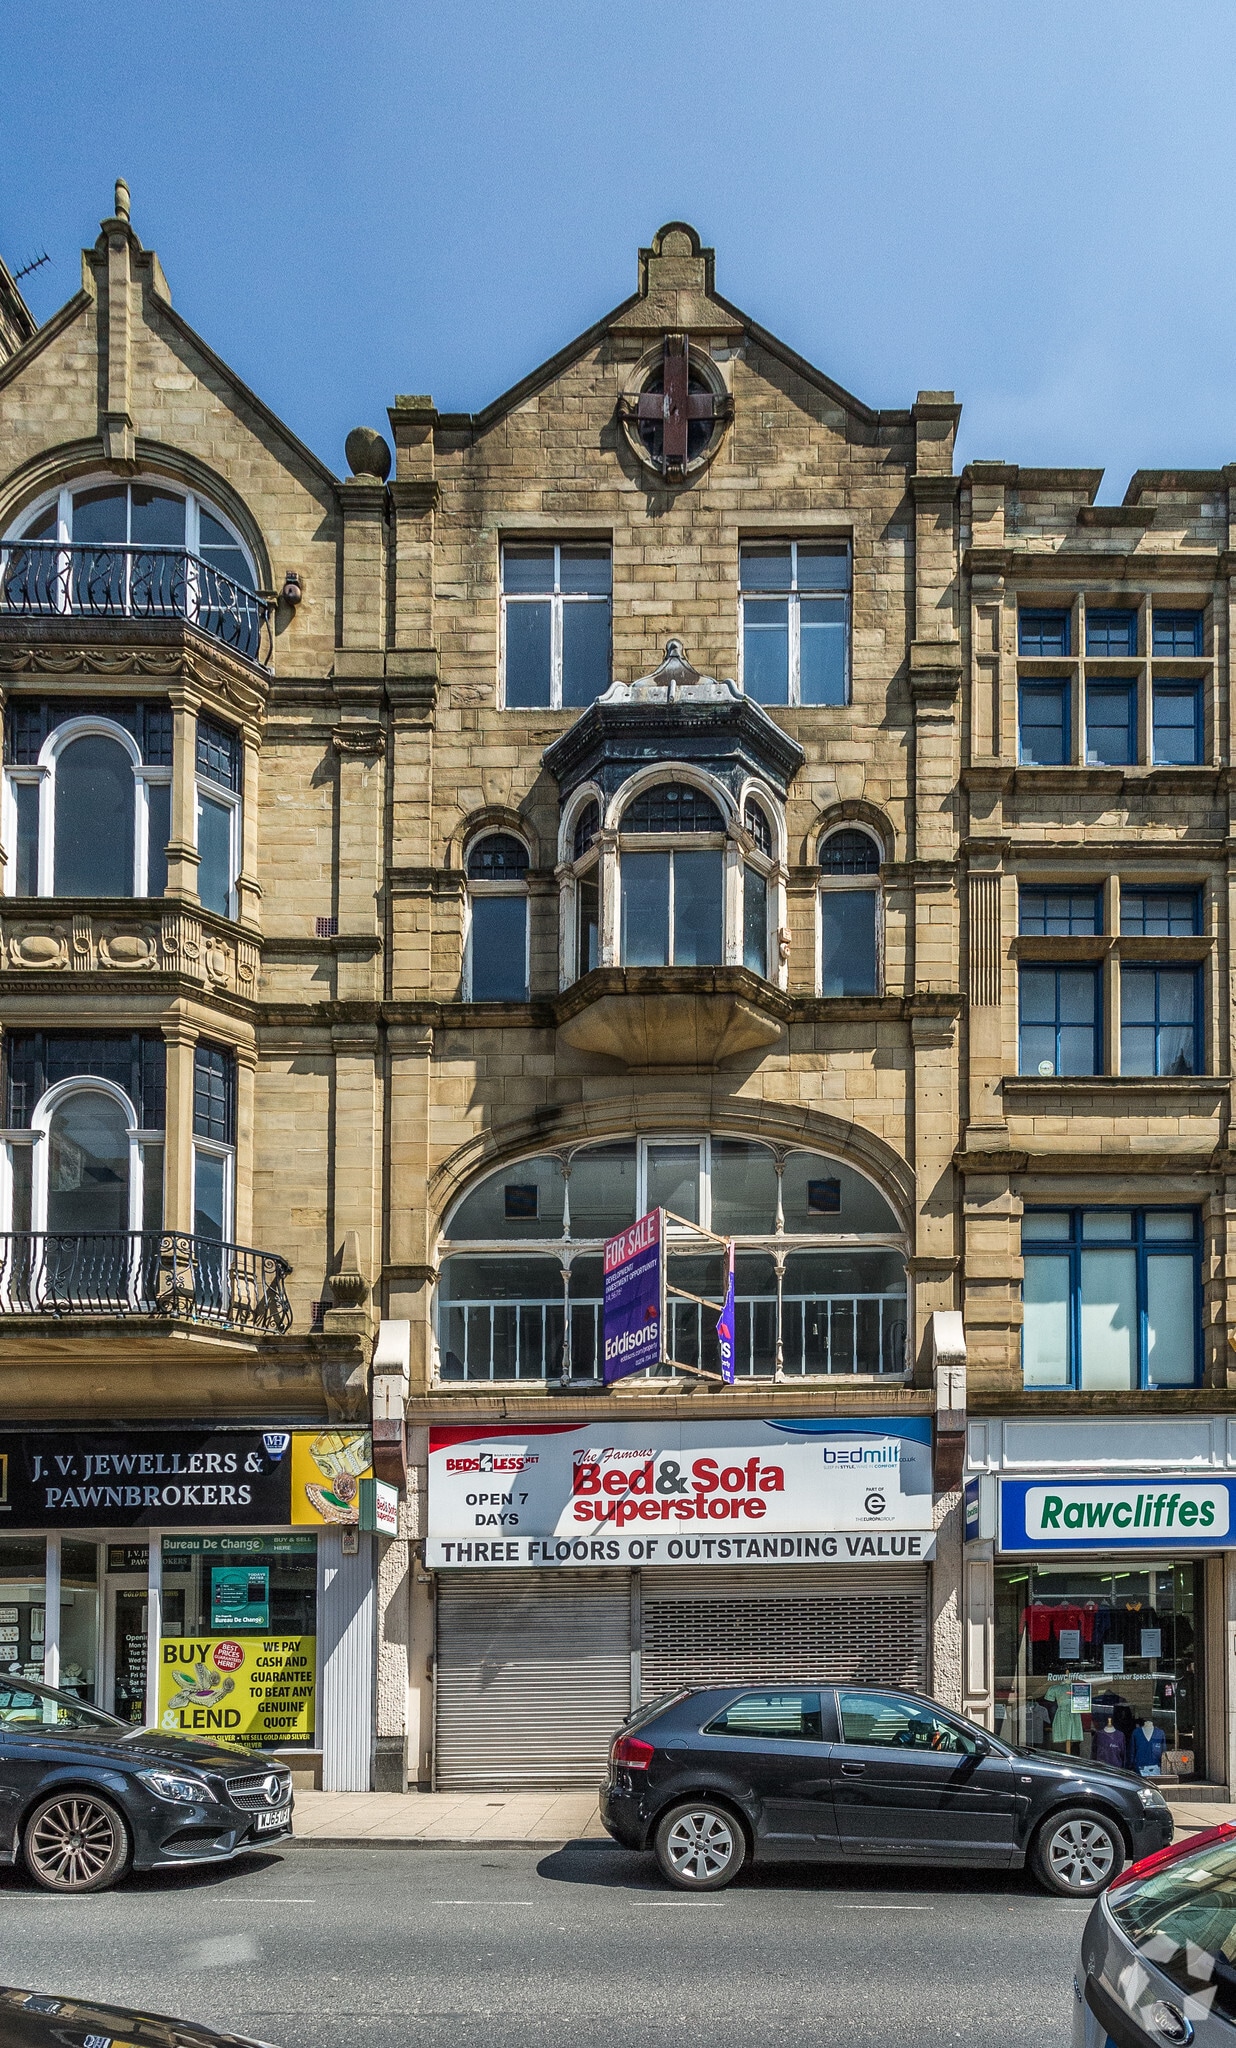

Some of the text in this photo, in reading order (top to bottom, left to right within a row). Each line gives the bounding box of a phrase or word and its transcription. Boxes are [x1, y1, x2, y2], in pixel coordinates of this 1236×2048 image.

[606, 1215, 655, 1271] FOR SALE
[605, 1258, 658, 1294] INVESTMENT OPPORTUNITY
[605, 1322, 658, 1361] Eddisons
[572, 1447, 654, 1466] The Famous
[32, 1452, 264, 1483] J. V. JEWELLERS &
[45, 1484, 252, 1508] PAWNBROKERS
[465, 1493, 529, 1506] OPEN 7
[573, 1493, 767, 1527] superstore
[1041, 1493, 1215, 1529] Rawcliffes
[475, 1513, 519, 1526] DAYS
[163, 1539, 260, 1550] Bureau De Change
[441, 1536, 921, 1562] THREE FLOORS OF OUTSTANDING VALUE
[243, 1616, 262, 1624] Change
[222, 1643, 239, 1652] BEST
[263, 1641, 302, 1652] WE PAY
[163, 1644, 211, 1664] BUY
[214, 1654, 242, 1663] GUARANTEED
[218, 1648, 240, 1659] PRICES
[217, 1659, 237, 1668] HERE!
[256, 1656, 307, 1667] CASH AND
[250, 1671, 312, 1682] GUARANTEE
[1047, 1672, 1087, 1681] Rawcliffes
[249, 1686, 314, 1698] TO BEAT ANY
[257, 1701, 304, 1713] GENUINE
[263, 1716, 298, 1729] QUOTE
